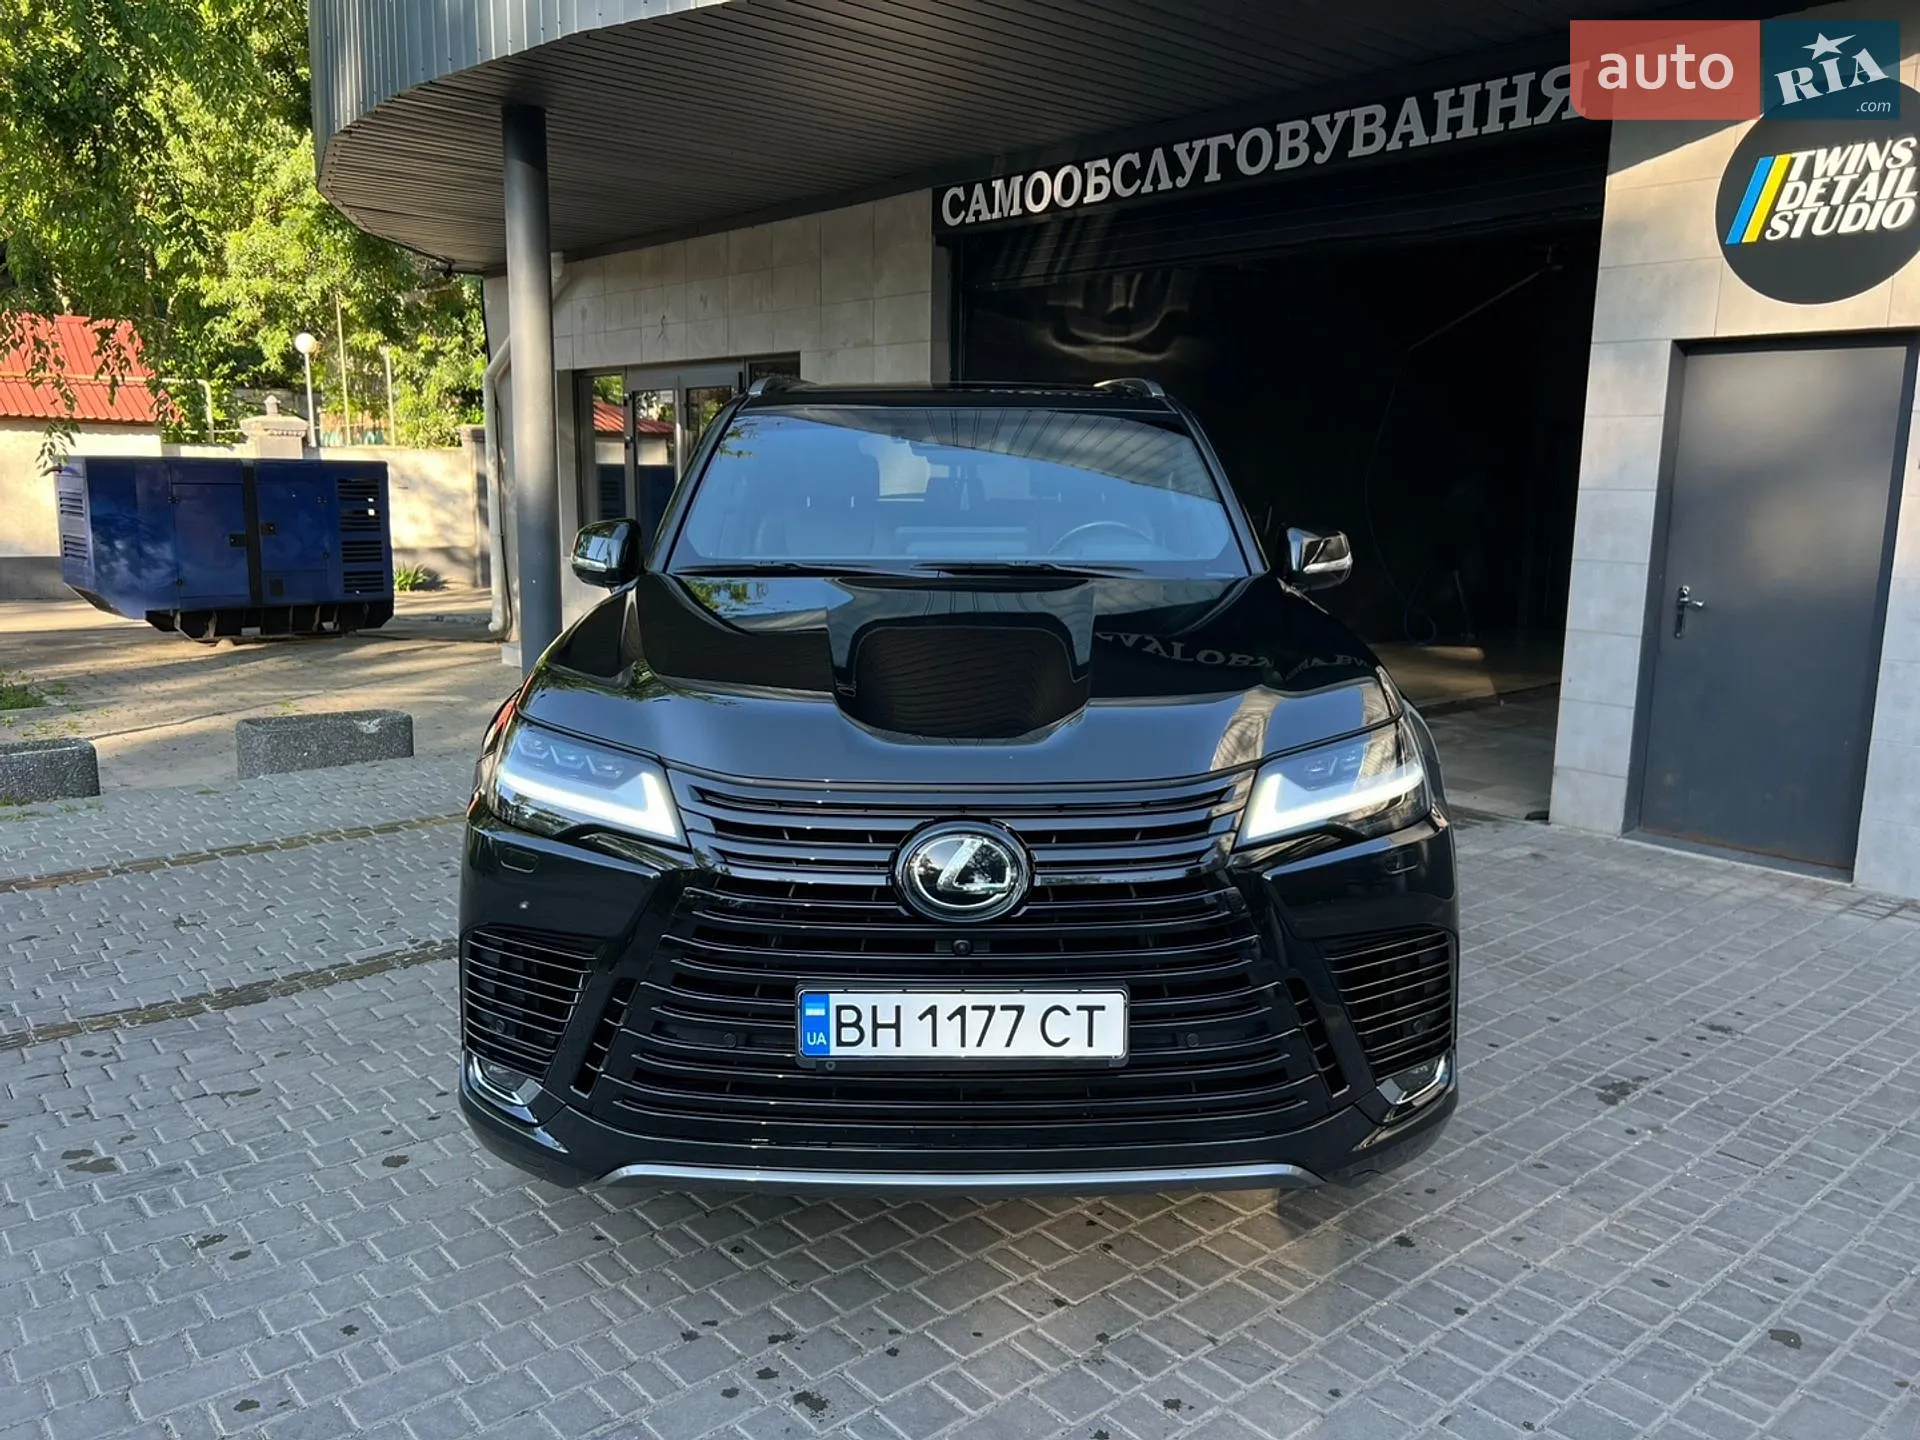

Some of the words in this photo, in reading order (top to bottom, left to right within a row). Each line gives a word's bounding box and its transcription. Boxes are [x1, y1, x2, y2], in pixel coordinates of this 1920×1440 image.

[942, 61, 1590, 226] САМООБСЛУГОВУВАННЯ
[1788, 136, 1917, 182] TWINS
[1775, 166, 1919, 212] DETAIL
[1765, 197, 1916, 241] STUDIO
[806, 1032, 827, 1046] UA
[835, 1004, 901, 1048] BH
[917, 1004, 1026, 1048] 1177
[1040, 1004, 1106, 1048] CT
